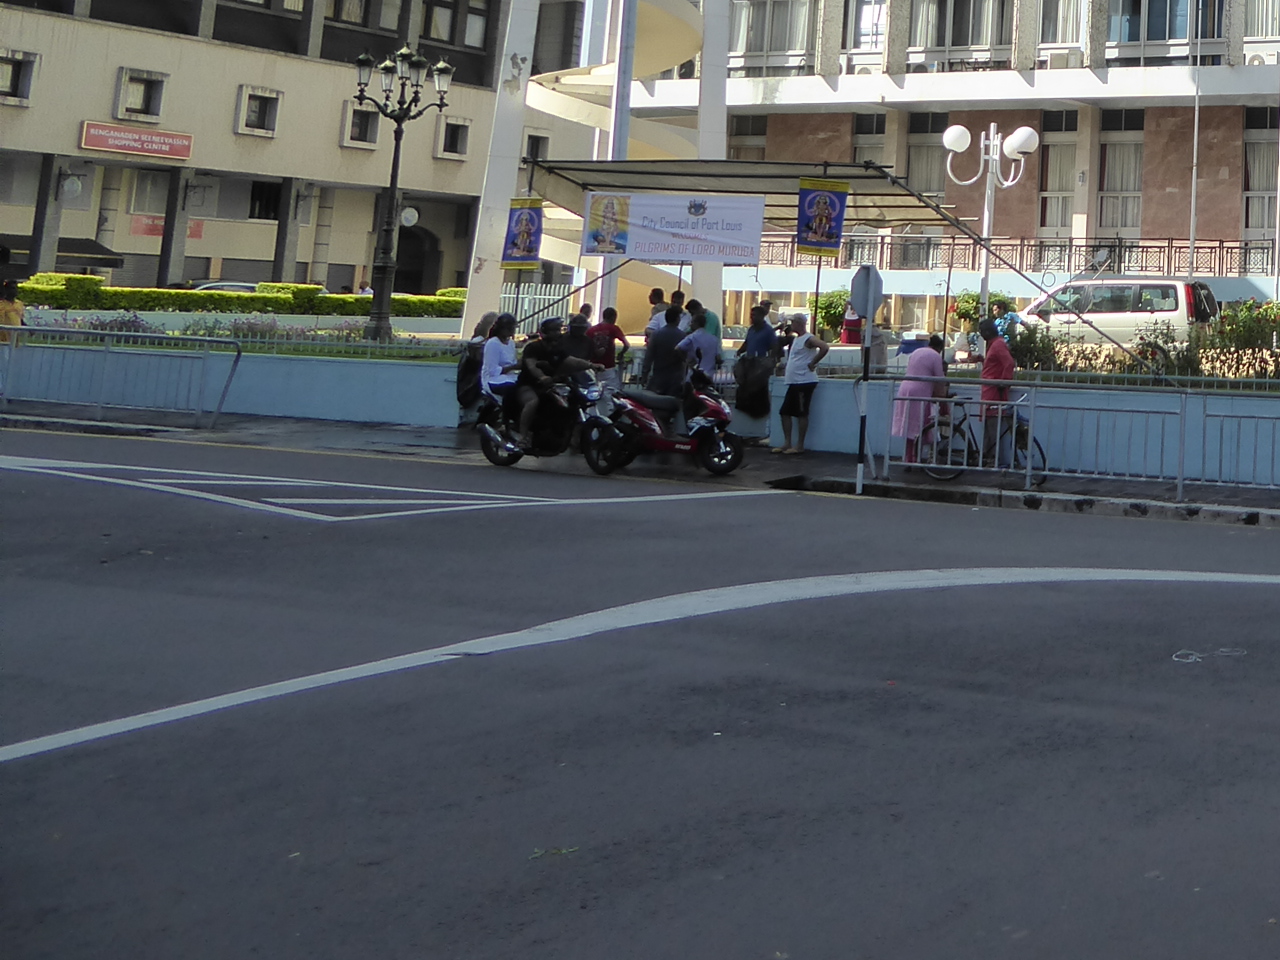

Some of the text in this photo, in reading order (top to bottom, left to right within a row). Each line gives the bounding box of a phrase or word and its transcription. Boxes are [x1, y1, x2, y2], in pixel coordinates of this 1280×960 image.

[108, 138, 170, 151] SHOPPING CENTRE
[641, 216, 743, 231] City Council of Port Louis
[634, 242, 755, 257] PILGRIMS OF LORD MURUGA
